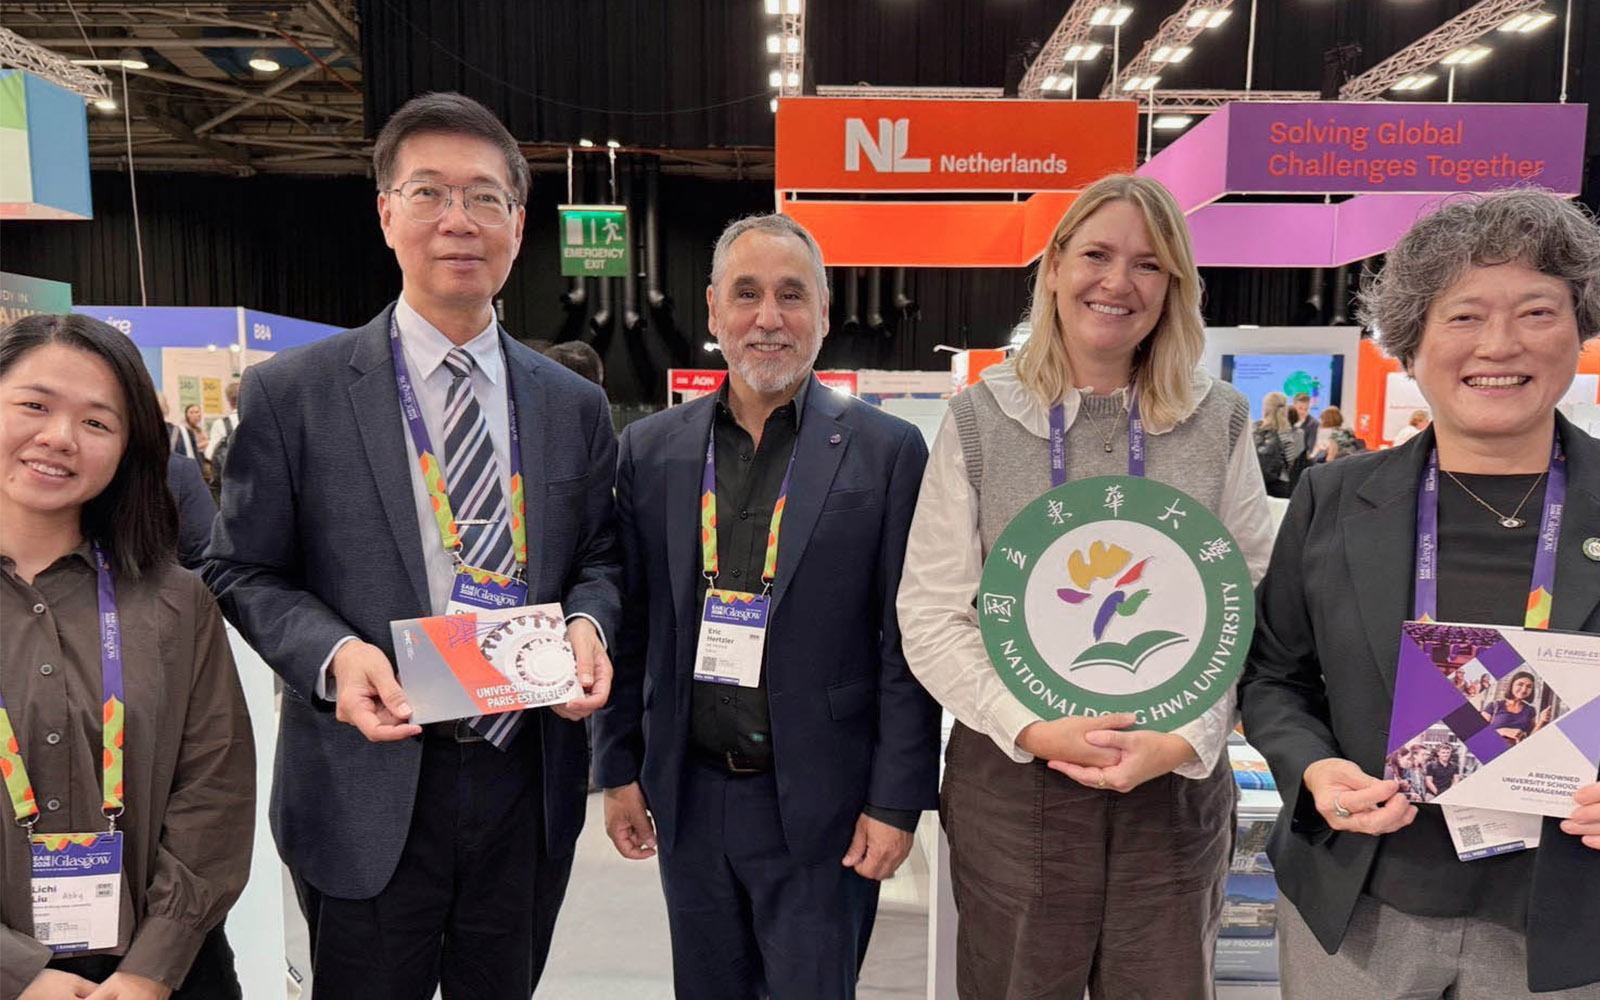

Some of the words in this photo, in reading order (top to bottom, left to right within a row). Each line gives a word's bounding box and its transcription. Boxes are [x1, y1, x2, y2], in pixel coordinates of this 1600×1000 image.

[1270, 119, 1369, 151] Solving
[1377, 120, 1463, 145] Global
[845, 118, 931, 172] NL
[940, 152, 1067, 173] Netherlands
[1268, 152, 1417, 183] Challenges
[1427, 154, 1544, 183] Together
[564, 247, 624, 258] EMERGENCY
[585, 259, 606, 270] EXIT
[692, 376, 715, 386] AON
[1420, 532, 1434, 567] Glasgow
[477, 587, 518, 606] Glasgow
[725, 606, 762, 621] Glasgow
[708, 627, 721, 635] Eric
[103, 624, 117, 660] Glasgow
[706, 635, 735, 645] Hertzler
[1001, 639, 1077, 717] NATIONAL
[1083, 707, 1147, 725] DG
[1150, 690, 1198, 721] HWA
[1193, 582, 1240, 691] UNIVERSITY
[1502, 777, 1545, 786] UNIVERSITY
[1547, 781, 1579, 790] SCHOOL
[1535, 773, 1581, 783] RENOWNED
[55, 855, 112, 869] Glasgow
[32, 885, 57, 894] Lichi
[1233, 939, 1273, 948] PROGRAM
